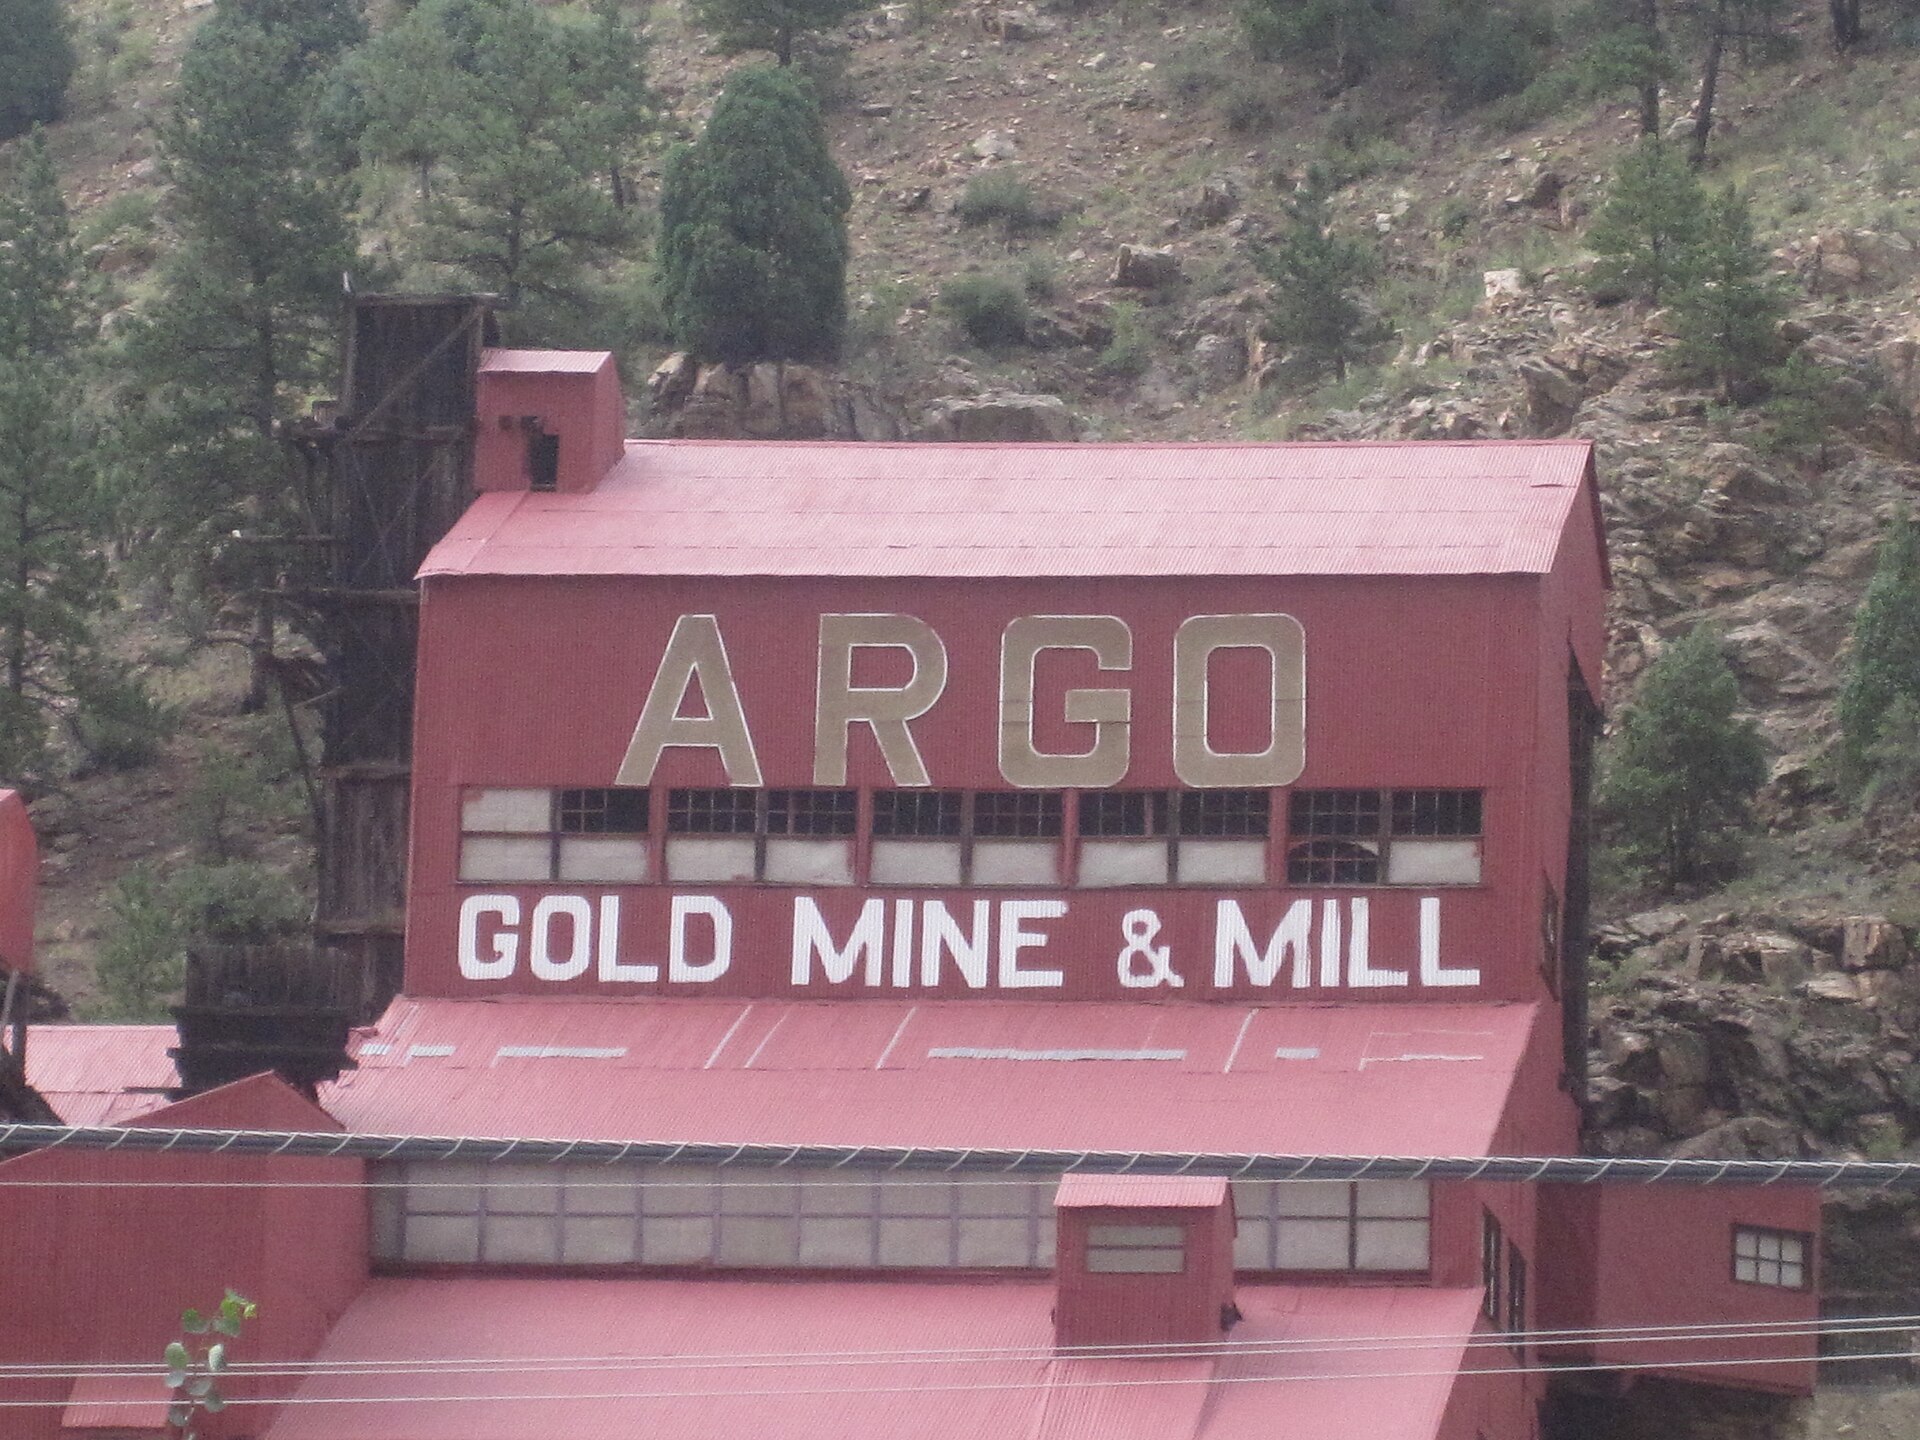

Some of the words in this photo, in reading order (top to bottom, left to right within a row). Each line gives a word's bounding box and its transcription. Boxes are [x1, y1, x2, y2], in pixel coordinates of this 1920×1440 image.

[614, 611, 1308, 788] ARGO
[458, 893, 733, 984] GOLD
[791, 896, 1069, 989] MINE
[1117, 909, 1184, 989] &
[1214, 897, 1481, 989] MILL
